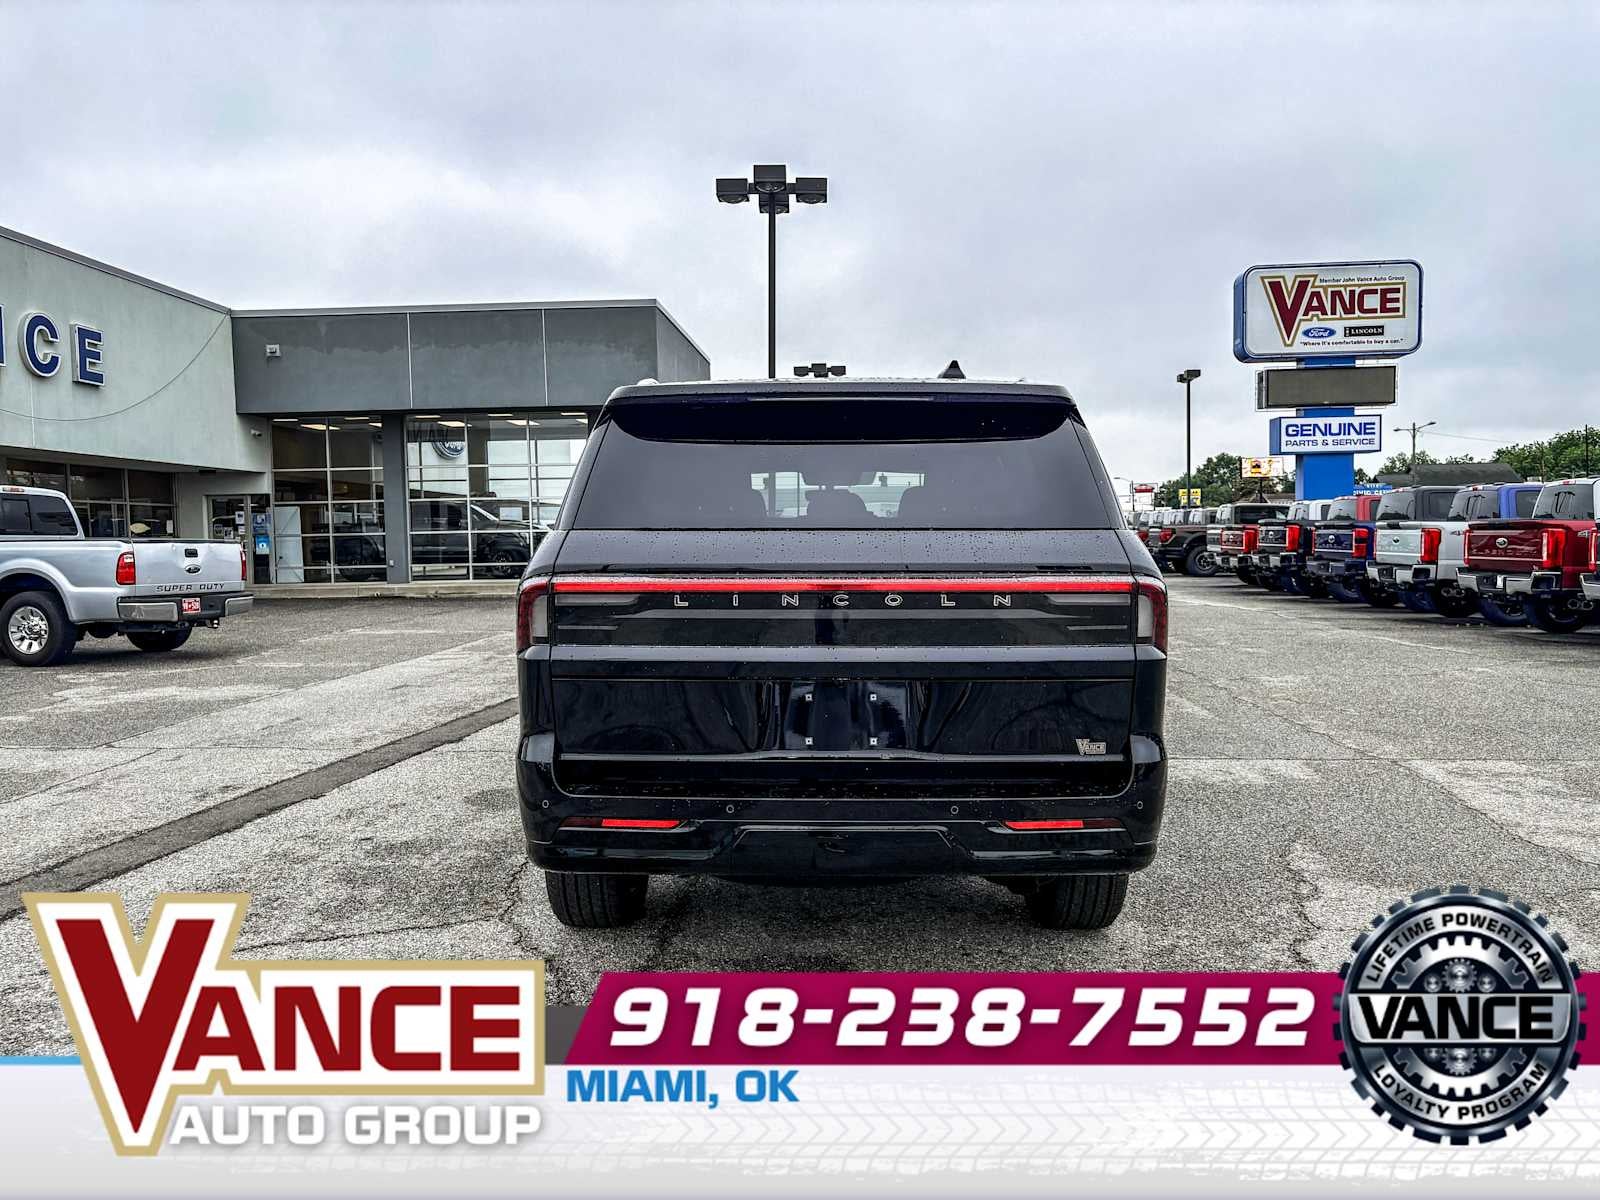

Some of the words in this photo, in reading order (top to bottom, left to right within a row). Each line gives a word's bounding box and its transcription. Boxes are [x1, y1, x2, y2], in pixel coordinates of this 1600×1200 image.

[1267, 279, 1402, 342] VANCE
[1308, 327, 1331, 338] Ford
[1351, 327, 1383, 335] LINCOLN
[0, 304, 105, 386] CE
[1285, 422, 1376, 438] GENUINE
[1285, 439, 1318, 448] PARTS
[1321, 439, 1329, 447] &
[1332, 438, 1376, 447] SERVICE
[156, 584, 192, 593] SUPER
[199, 583, 225, 591] DUTY
[673, 593, 1012, 608] LINCOLN
